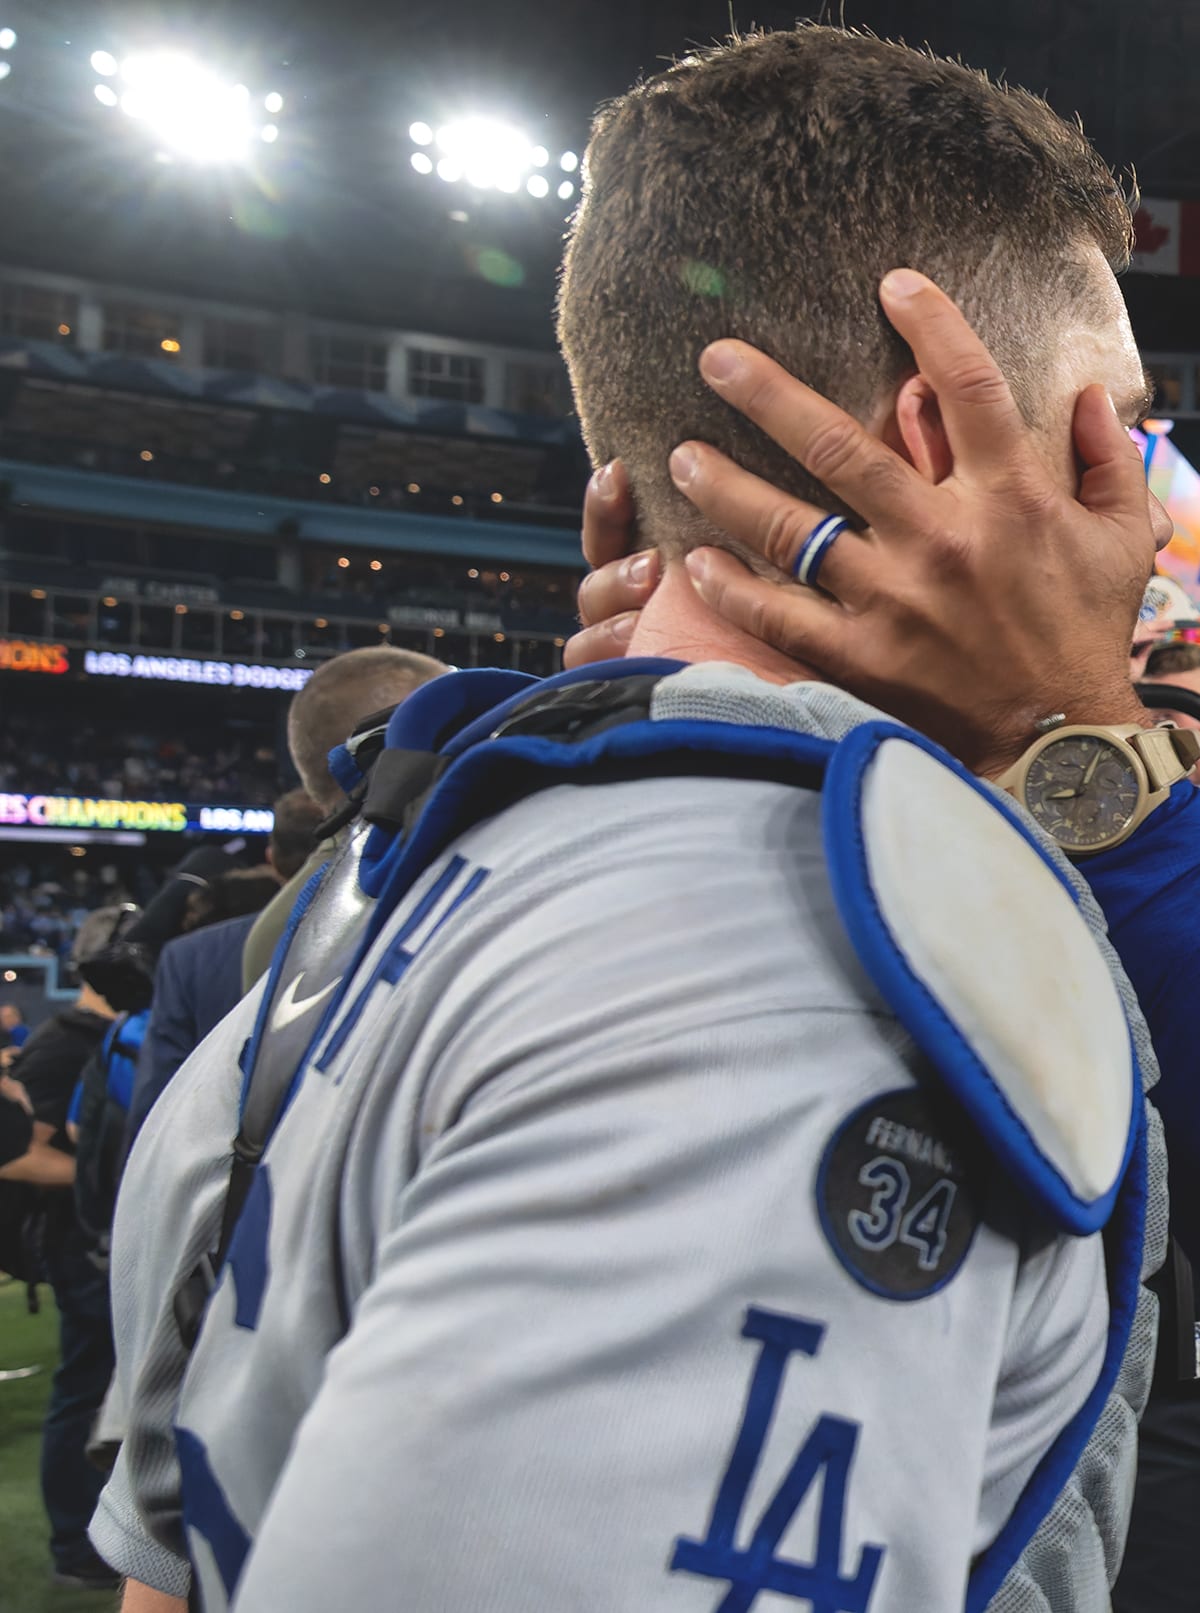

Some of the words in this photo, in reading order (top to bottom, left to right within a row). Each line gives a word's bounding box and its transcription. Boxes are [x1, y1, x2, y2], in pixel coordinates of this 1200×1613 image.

[84, 650, 132, 677] LOS
[132, 655, 232, 685] ANGELES
[28, 796, 187, 832] CHAMPIONS
[847, 1155, 957, 1271] 34
[669, 1303, 888, 1613] LA
